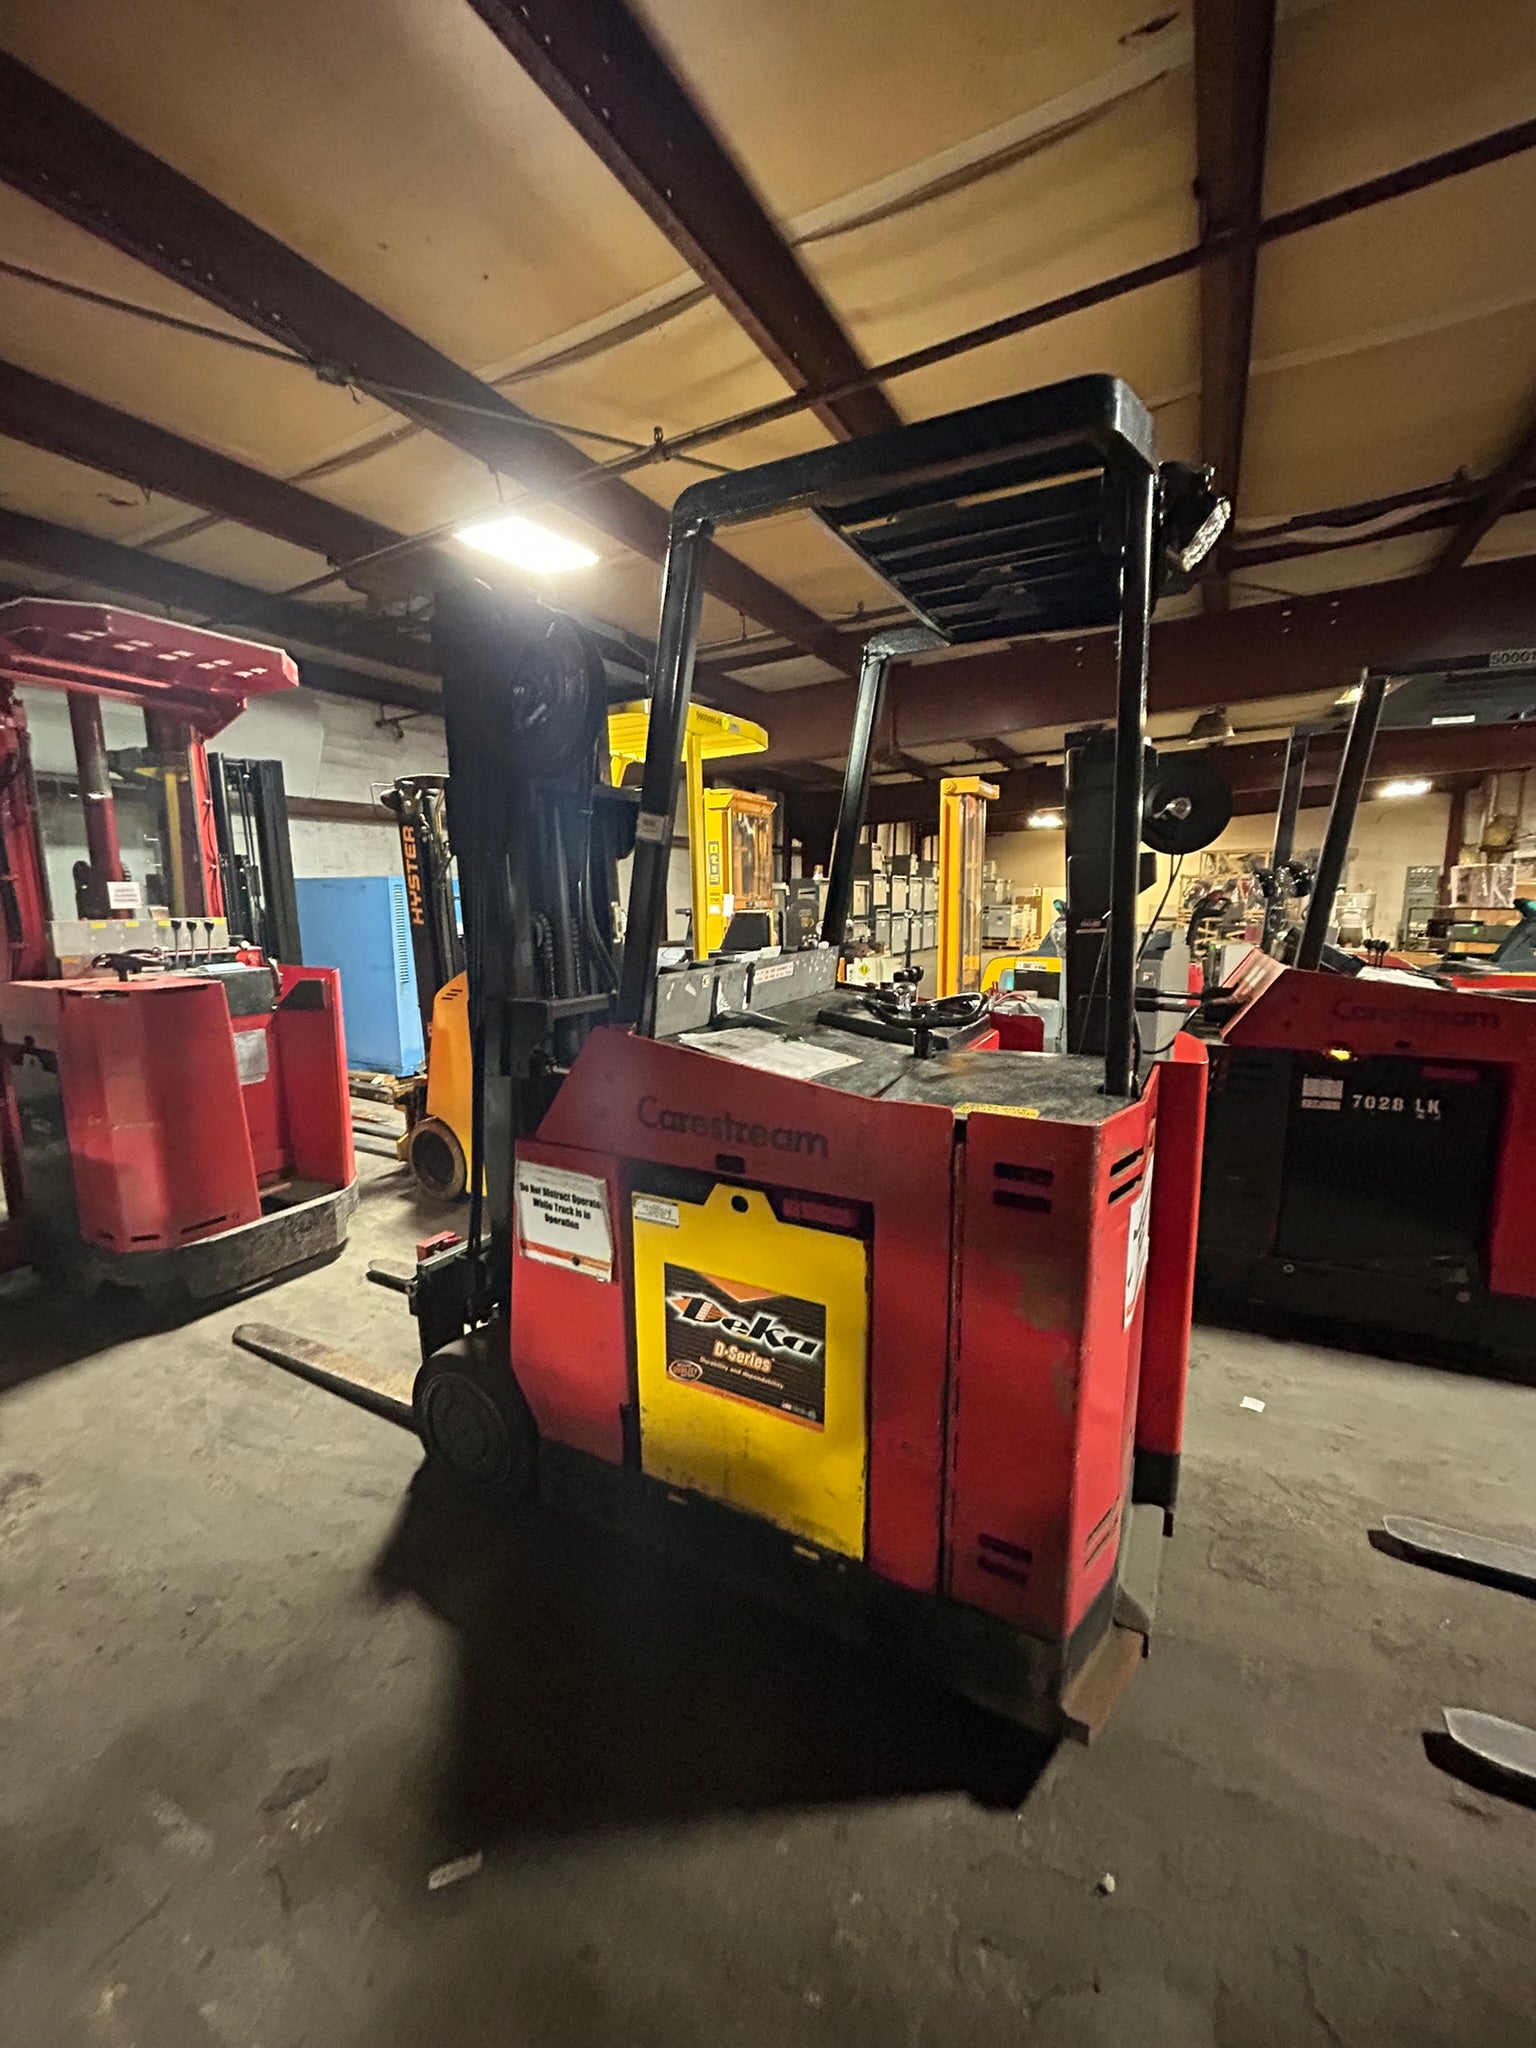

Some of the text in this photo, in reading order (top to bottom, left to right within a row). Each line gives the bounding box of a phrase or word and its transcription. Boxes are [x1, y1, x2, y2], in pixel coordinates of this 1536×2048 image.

[402, 825, 424, 926] HYSTER
[1352, 1094, 1404, 1111] 7028
[637, 1095, 829, 1159] Carestream
[542, 1188, 571, 1202] Distract
[533, 1197, 553, 1211] While
[554, 1202, 574, 1216] Truck
[544, 1213, 579, 1229] Operation
[668, 1294, 820, 1357] Deka
